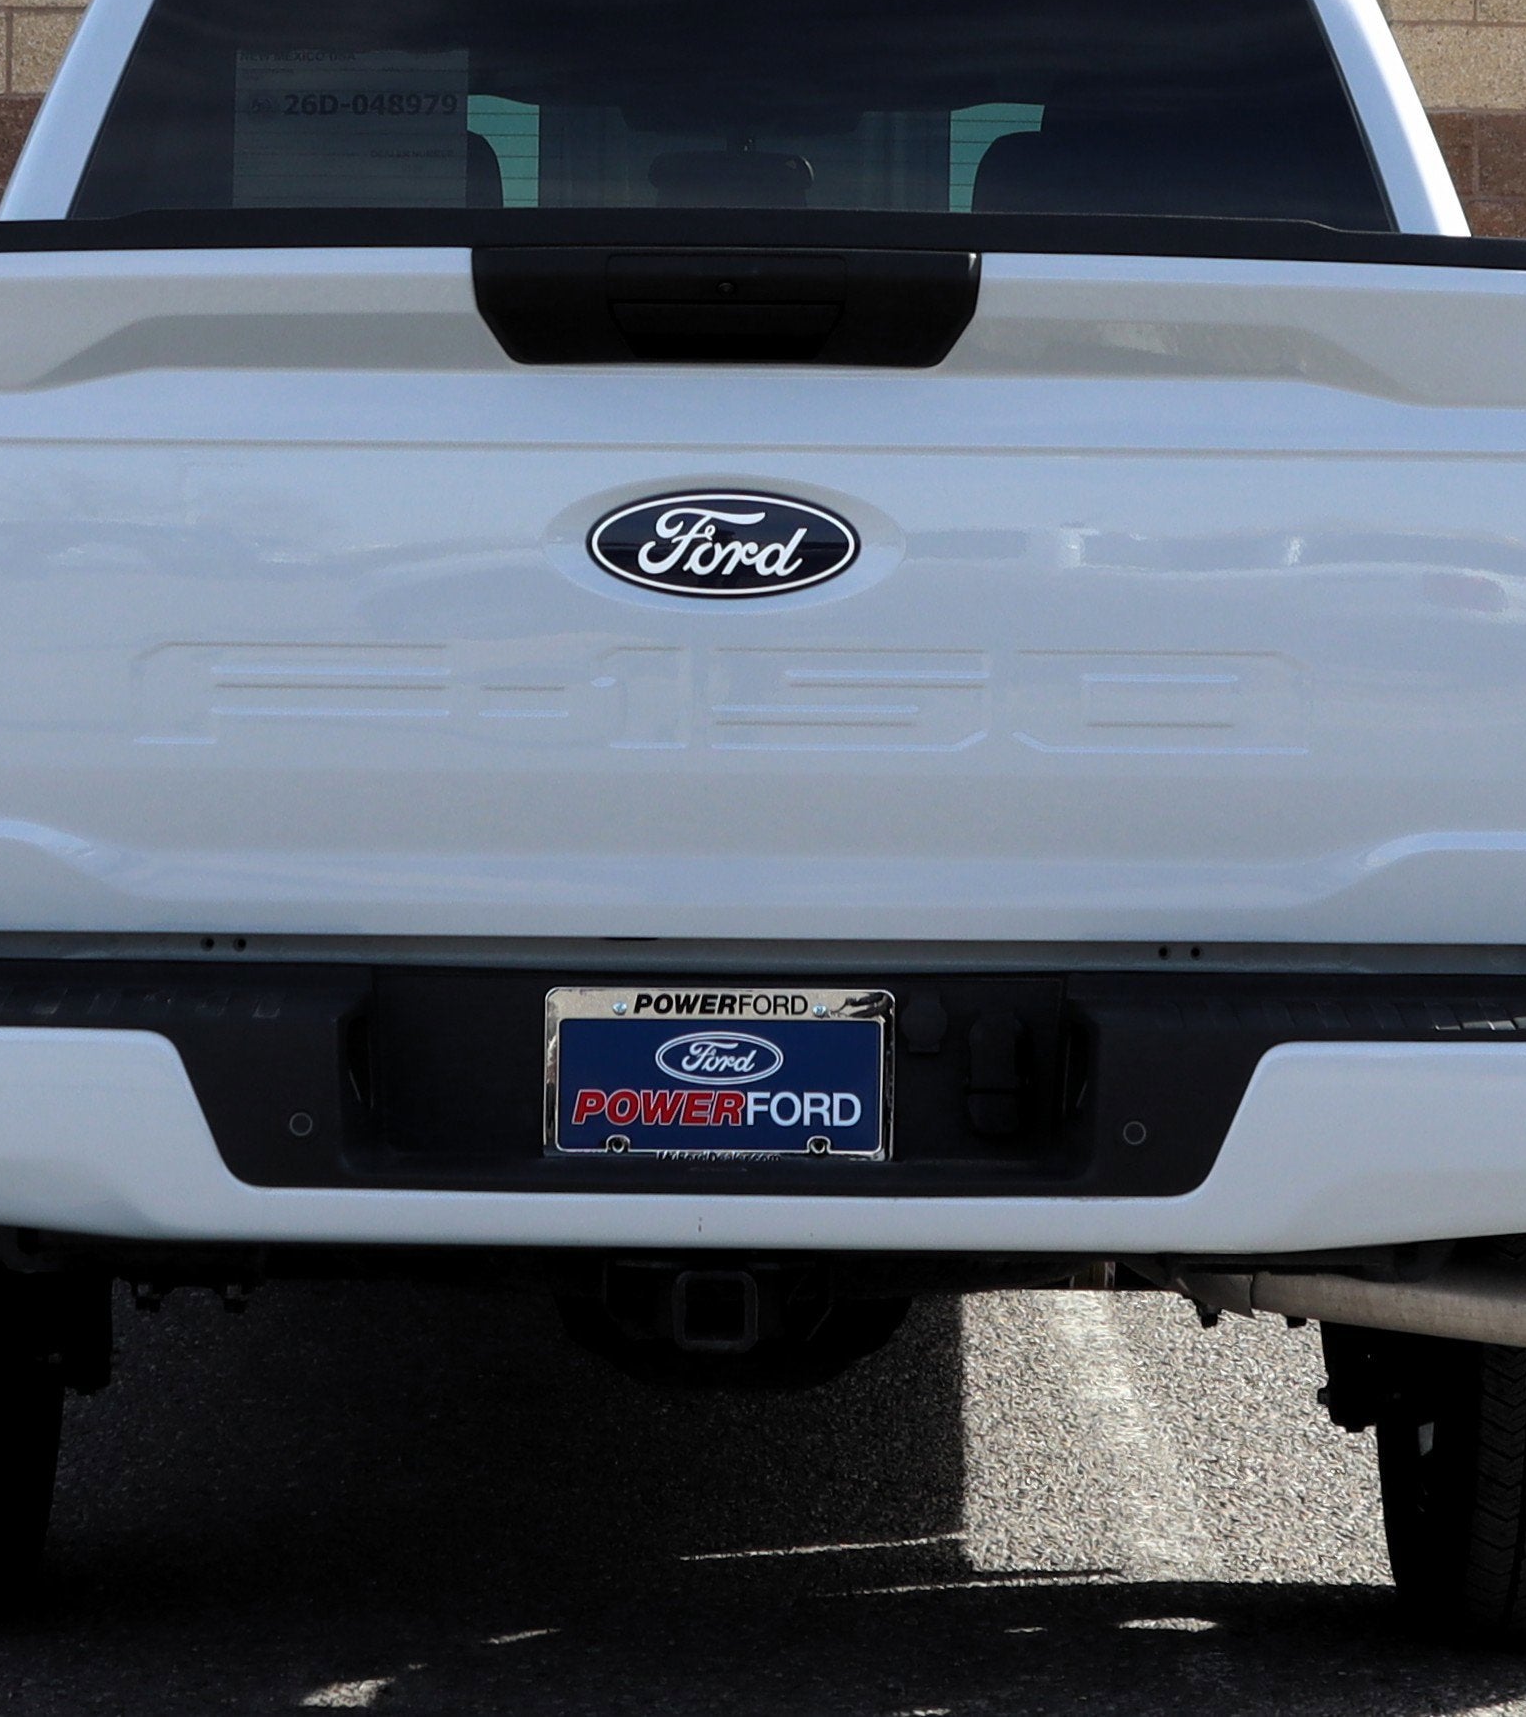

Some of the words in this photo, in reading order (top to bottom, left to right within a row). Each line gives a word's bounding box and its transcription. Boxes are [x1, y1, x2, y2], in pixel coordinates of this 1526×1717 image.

[284, 93, 458, 116] 26D-048979
[637, 507, 808, 577] Ford
[633, 993, 809, 1016] POWERFORD
[680, 1041, 757, 1073] Ford
[572, 1088, 862, 1127] POWERFORD
